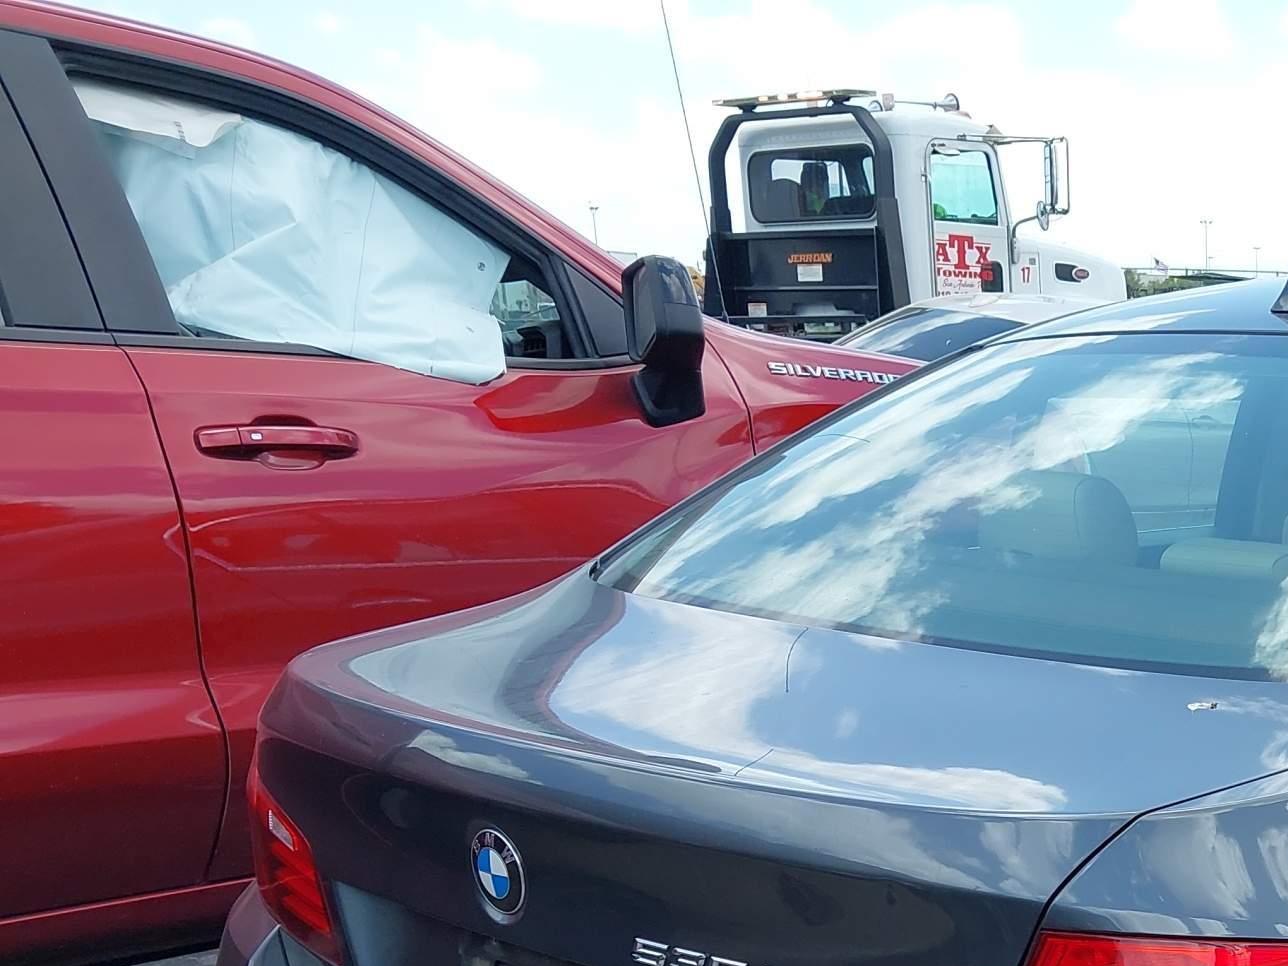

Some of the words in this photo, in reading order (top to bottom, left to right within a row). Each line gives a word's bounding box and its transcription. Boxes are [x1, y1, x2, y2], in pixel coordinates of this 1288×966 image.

[935, 233, 992, 270] ATX
[1020, 266, 1031, 283] 17
[471, 832, 516, 864] BMW
